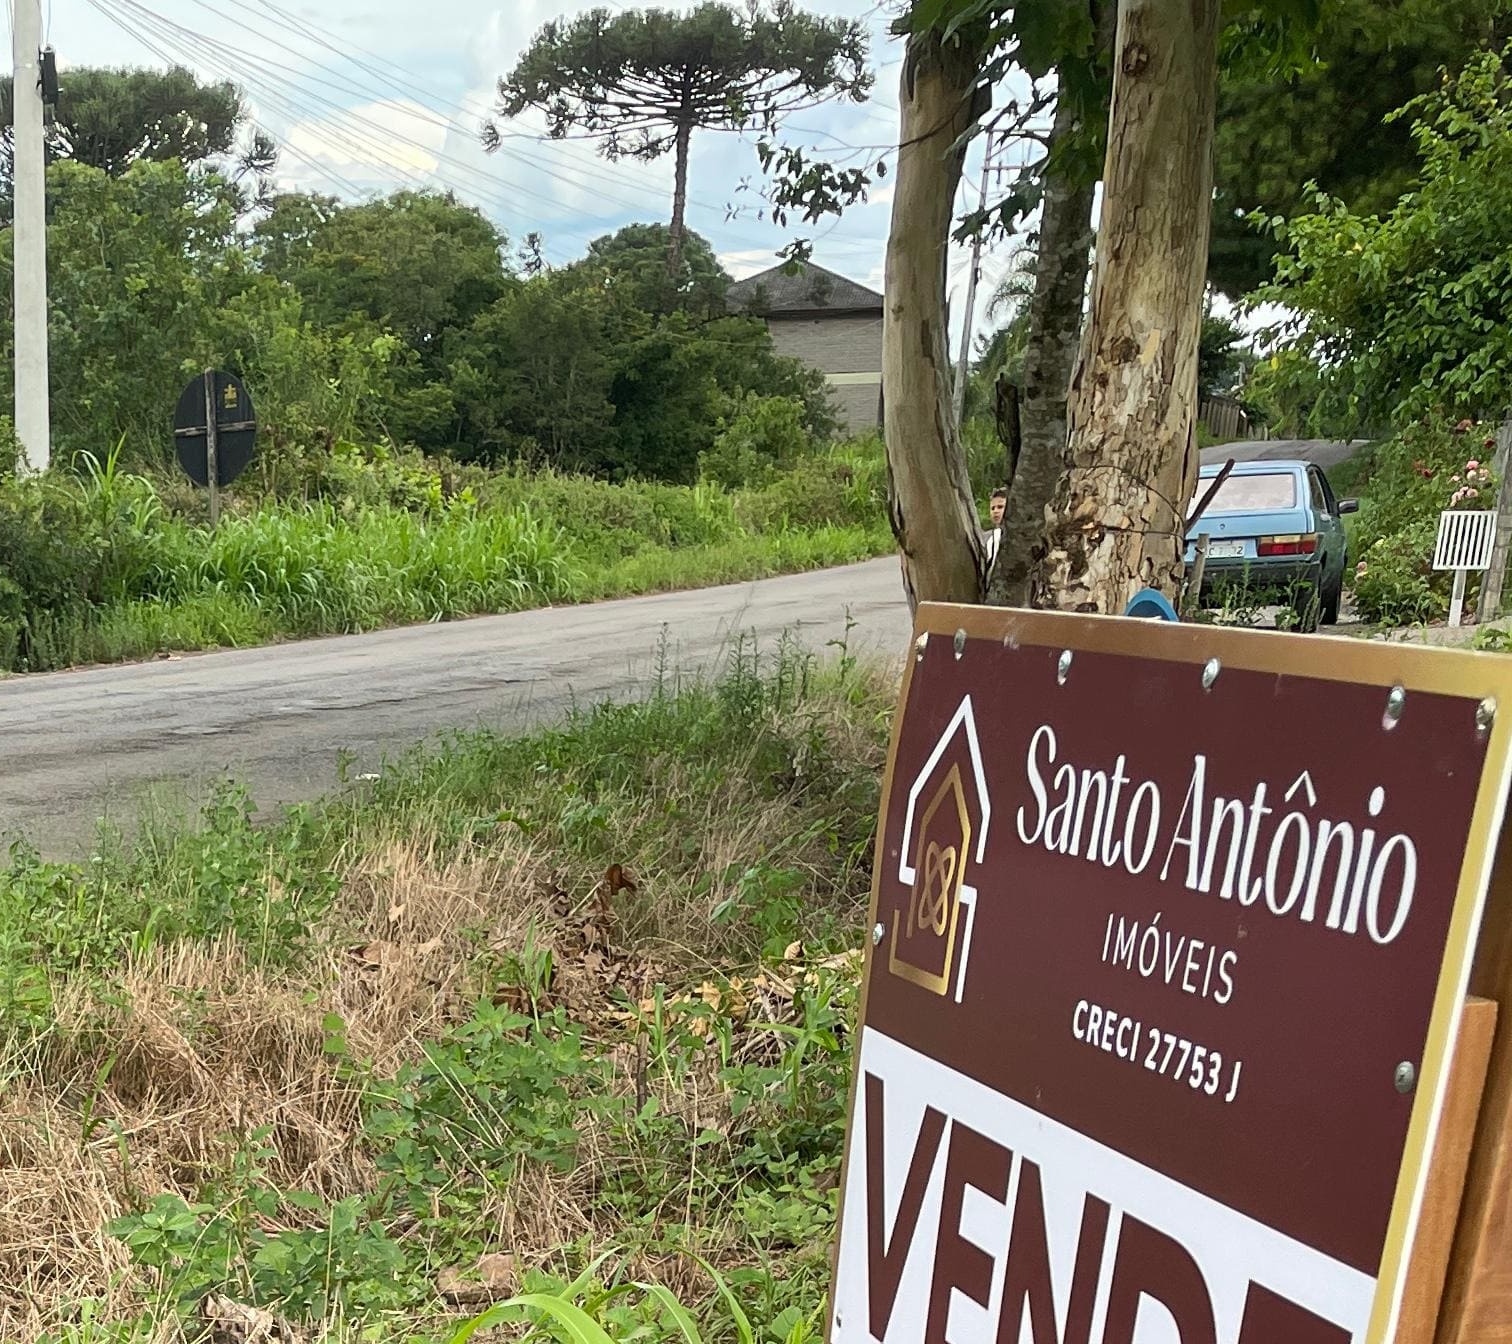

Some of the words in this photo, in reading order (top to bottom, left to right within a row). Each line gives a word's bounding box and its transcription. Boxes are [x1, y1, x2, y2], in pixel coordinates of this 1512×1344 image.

[1016, 725, 1161, 875] Santo
[1159, 755, 1418, 945] Antônio
[1102, 911, 1238, 1005] IMÓVEIS
[1072, 999, 1142, 1062] CRECI
[1143, 1028, 1222, 1095] 27753
[1224, 1061, 1243, 1103] J
